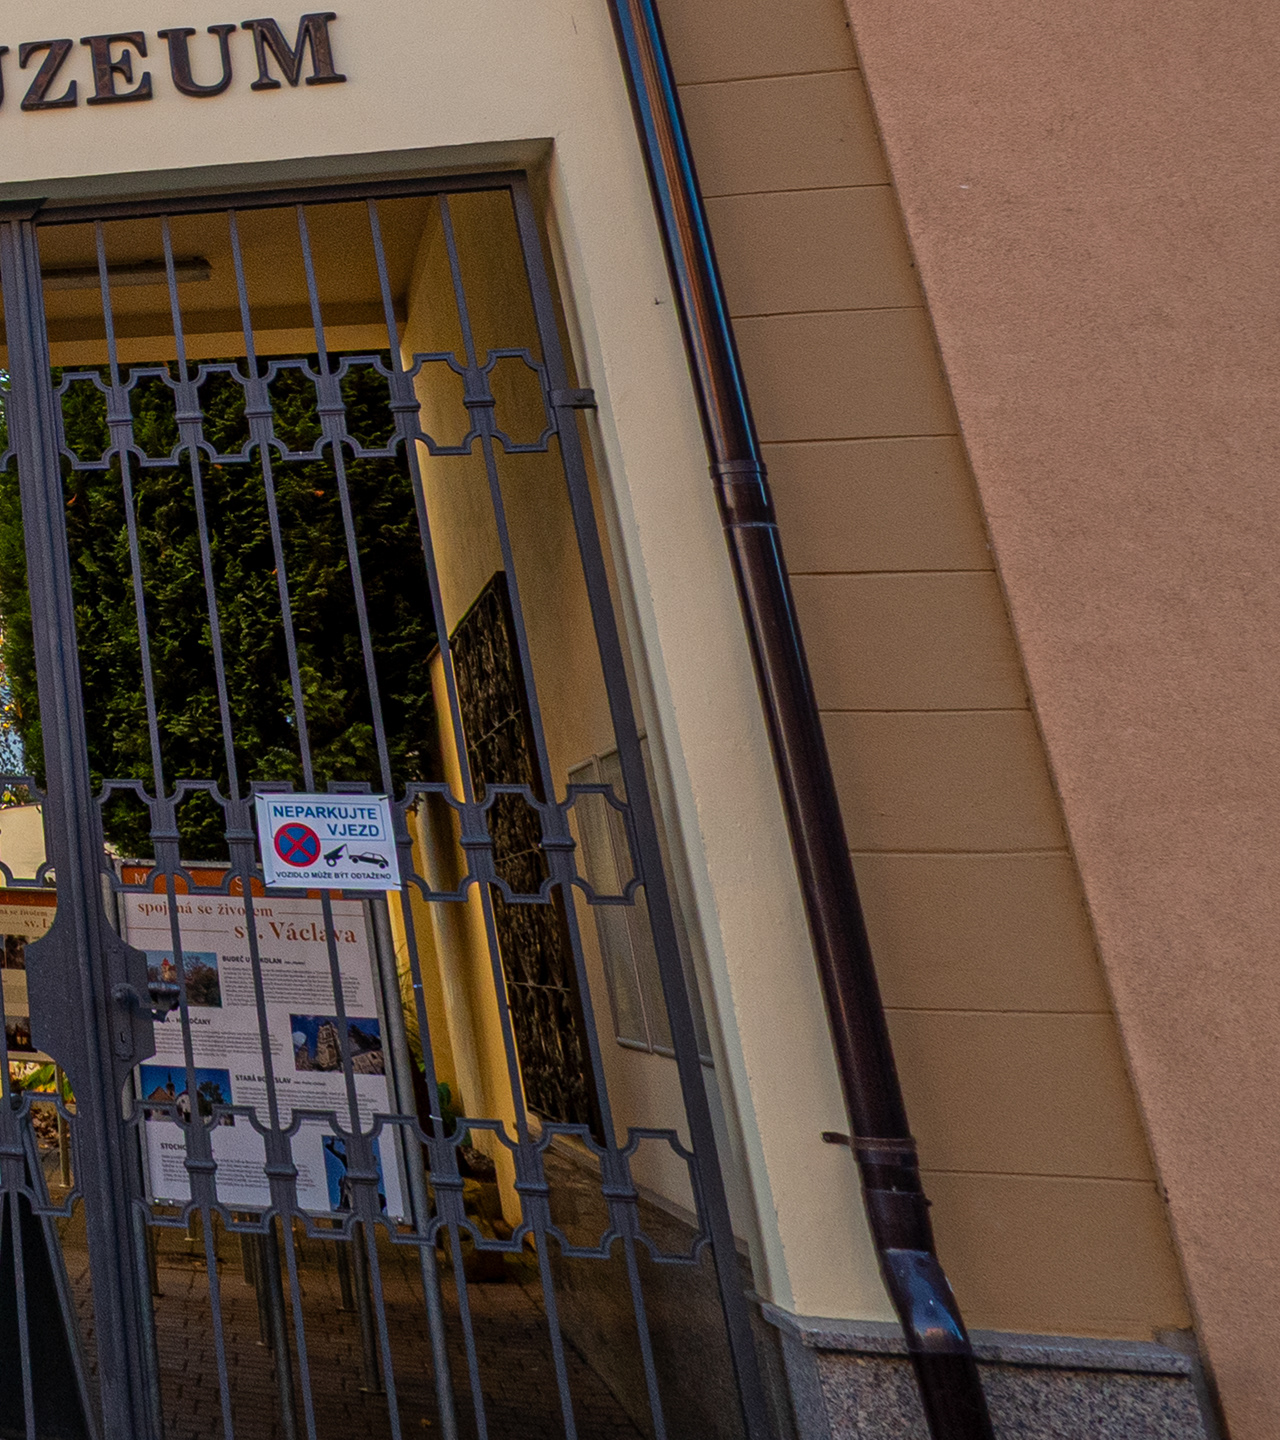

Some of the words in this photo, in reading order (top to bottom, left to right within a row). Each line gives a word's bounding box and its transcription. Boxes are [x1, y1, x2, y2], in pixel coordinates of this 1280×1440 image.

[272, 805, 378, 820] NEPARKUJTE
[327, 823, 379, 837] VJEZD
[312, 870, 332, 879] MŮŽE
[334, 871, 349, 879] BÝT
[351, 871, 392, 880] ODTAŽENO
[138, 901, 193, 917] spojná
[197, 905, 213, 915] se
[217, 903, 273, 918] živoem
[269, 921, 357, 944] Václava
[235, 1074, 257, 1082] STARÁ
[258, 1074, 292, 1085] BOSLAV
